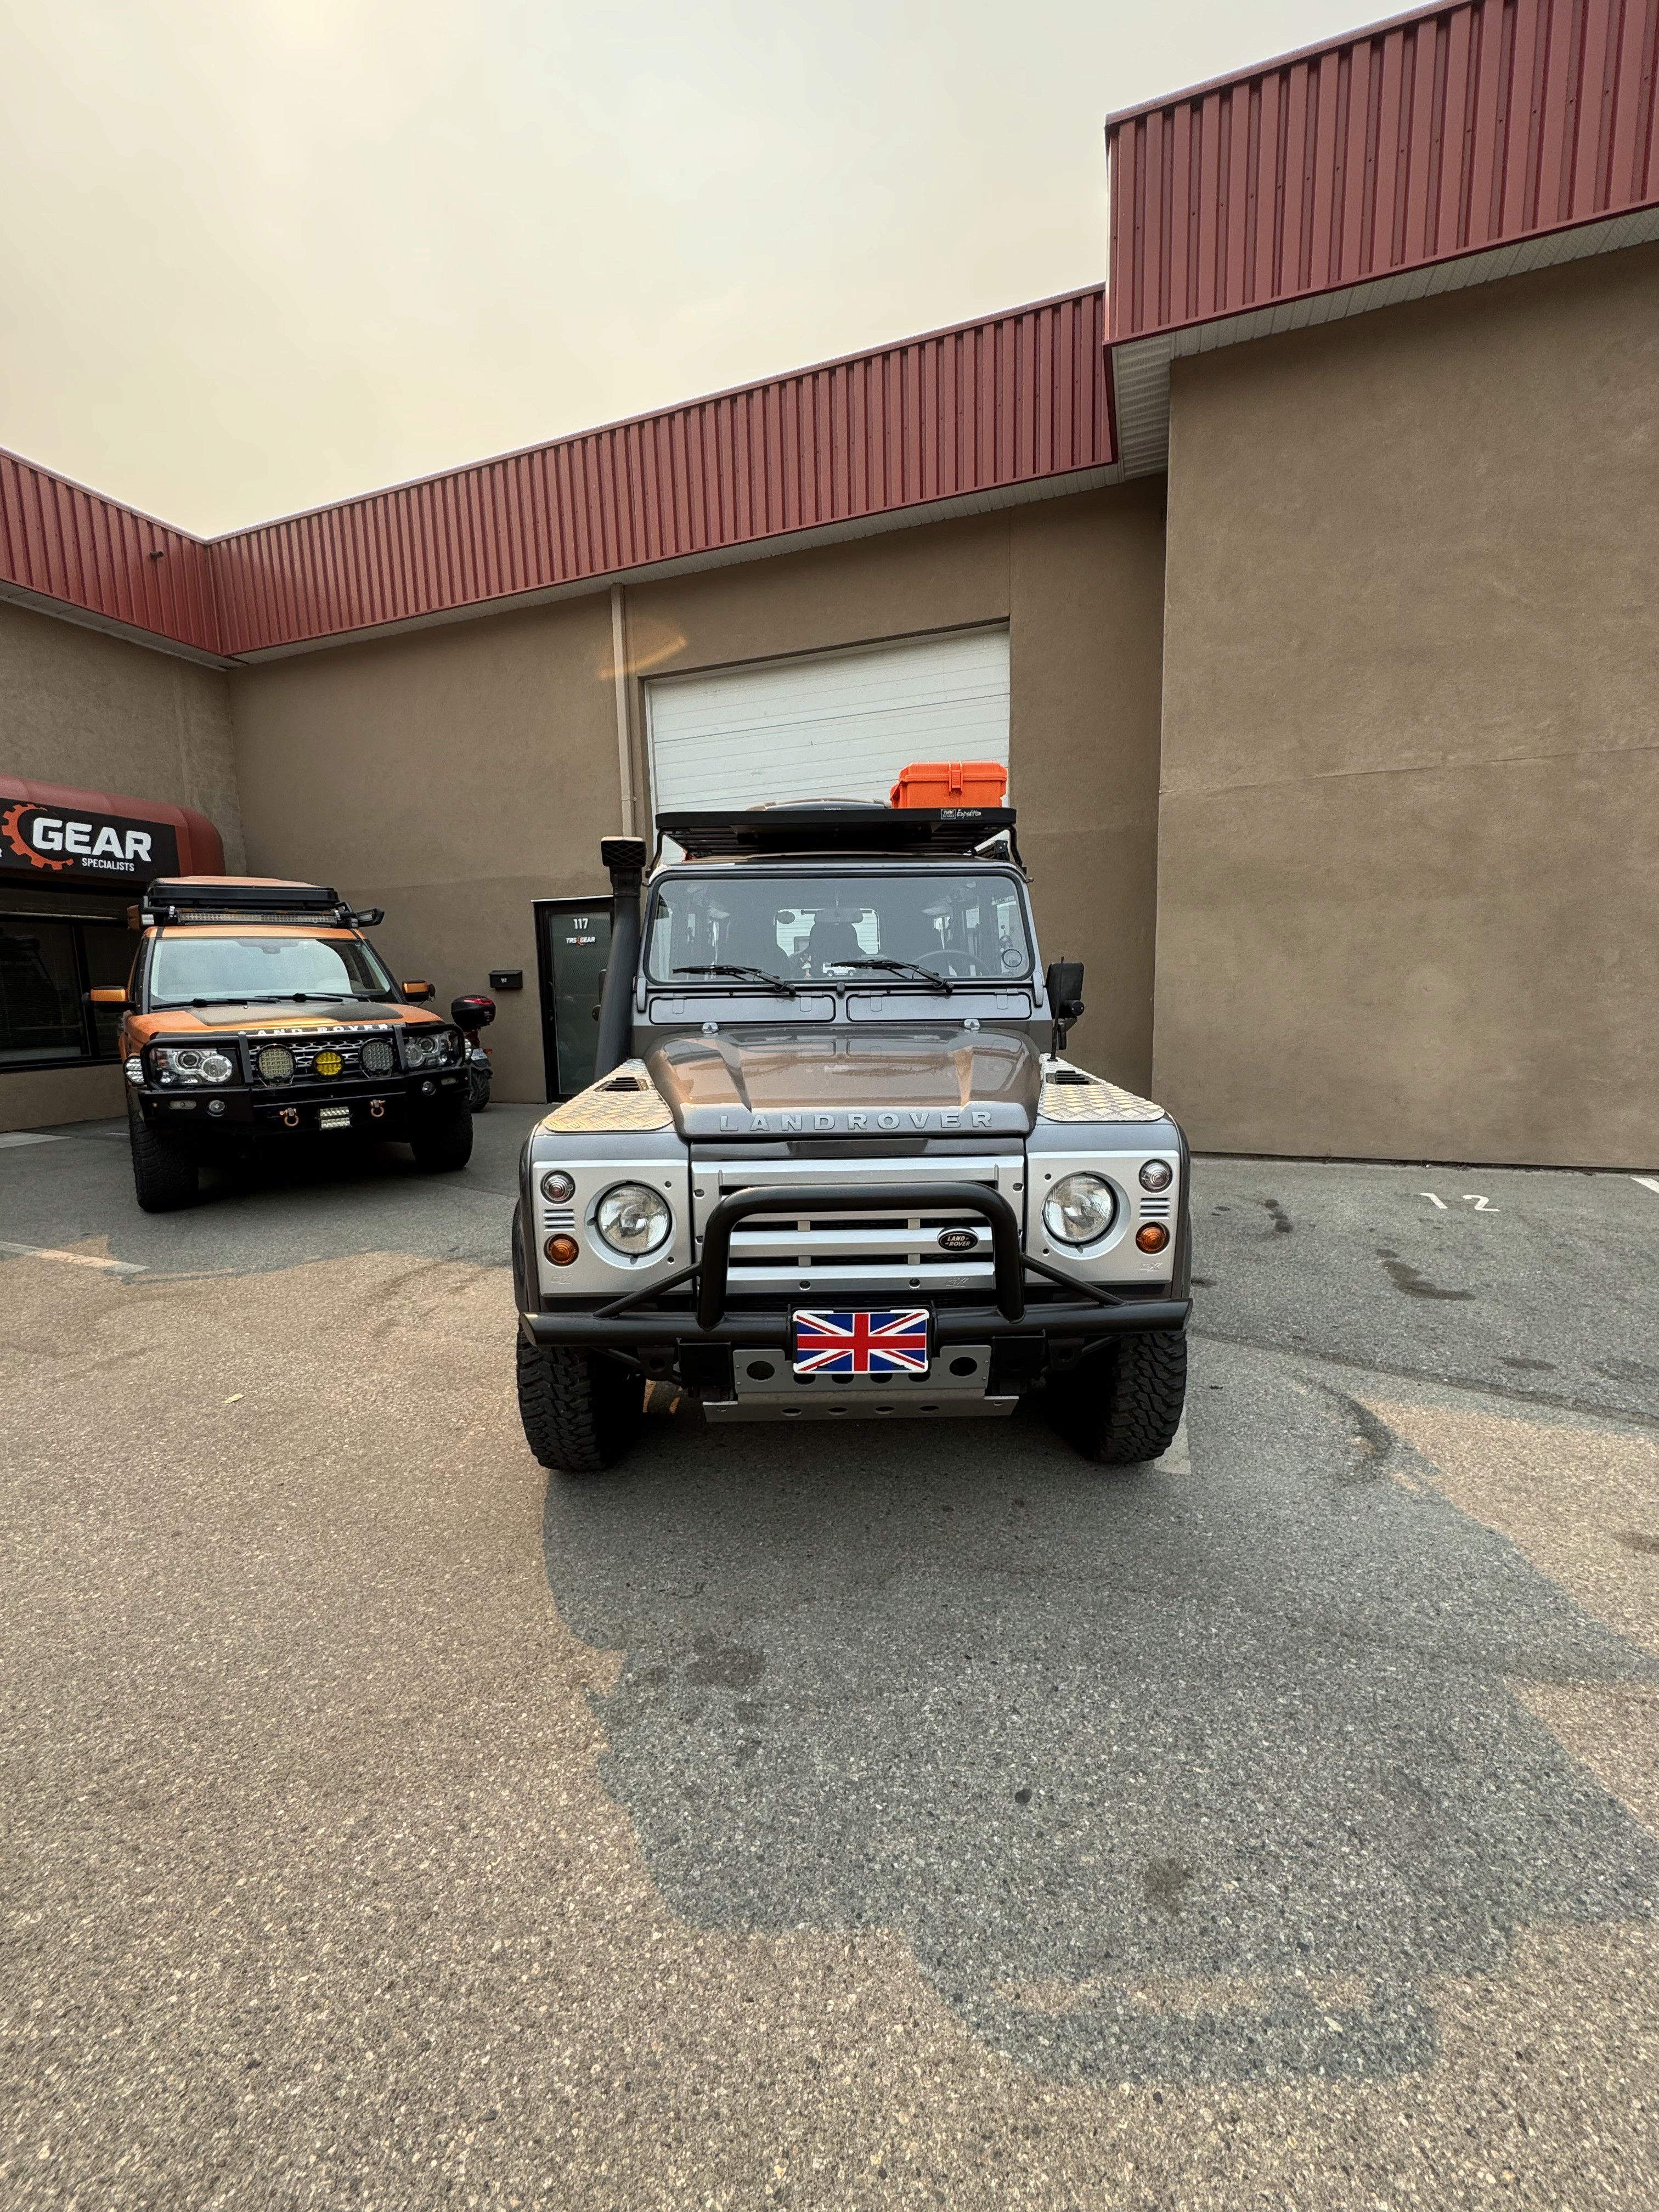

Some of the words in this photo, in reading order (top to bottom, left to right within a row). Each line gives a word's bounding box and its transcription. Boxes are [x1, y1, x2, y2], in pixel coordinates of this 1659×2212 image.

[32, 817, 152, 862] GEAR
[82, 857, 134, 872] SPECIALISTS
[573, 918, 588, 929] 117
